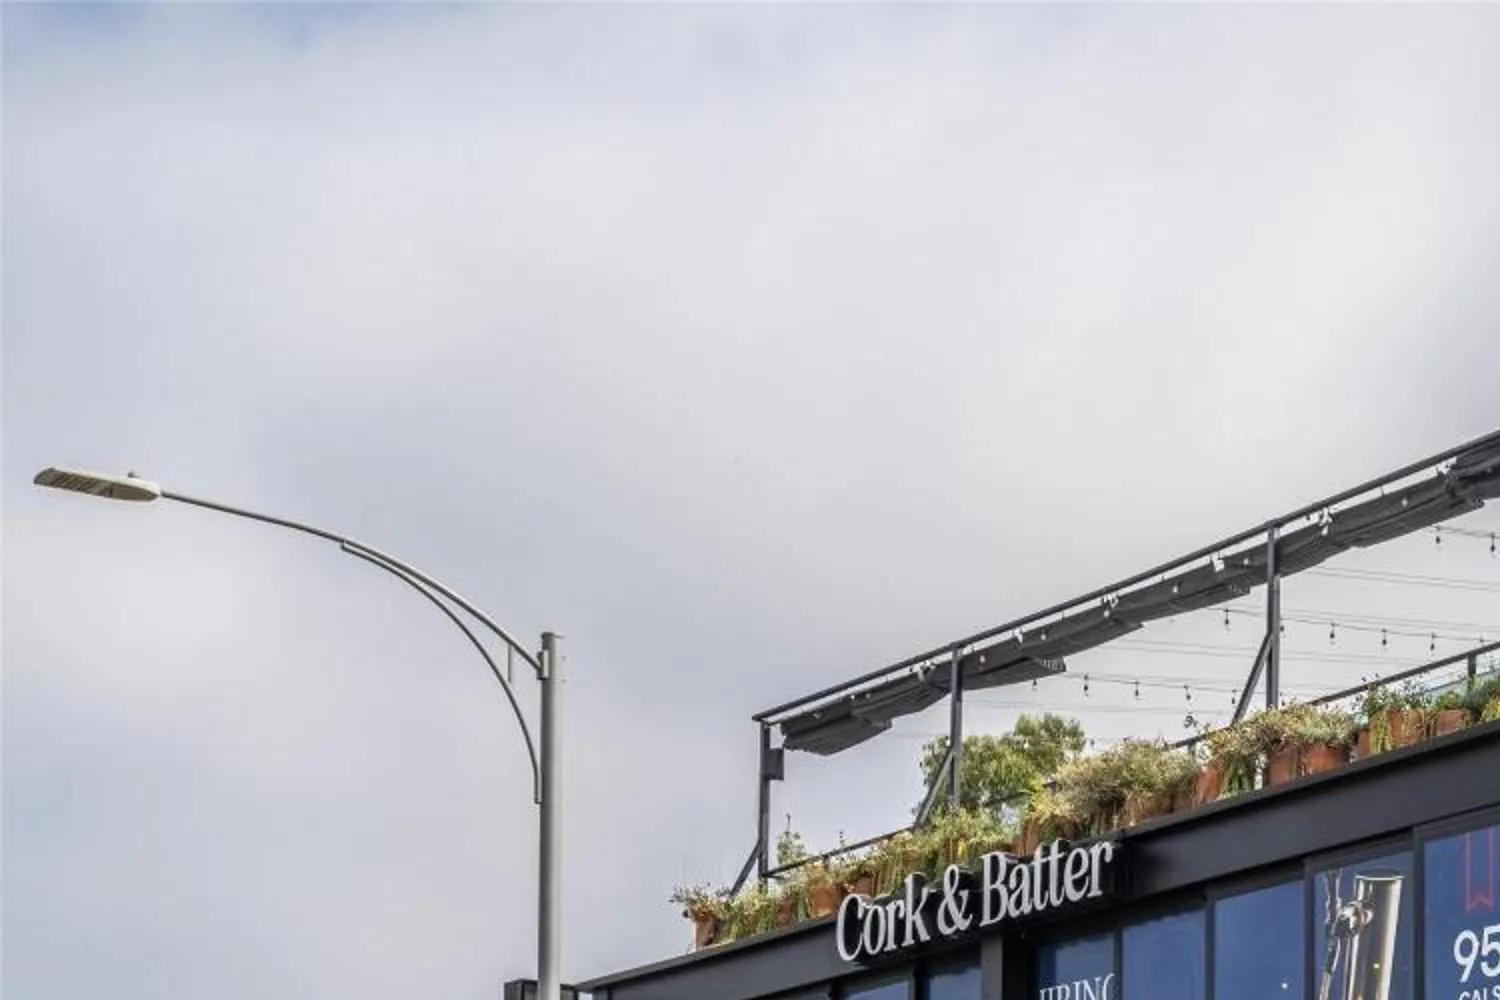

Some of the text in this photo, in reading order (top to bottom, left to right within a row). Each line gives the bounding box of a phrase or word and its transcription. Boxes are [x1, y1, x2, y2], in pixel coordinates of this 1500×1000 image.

[836, 838, 1113, 961] Cork & Batter
